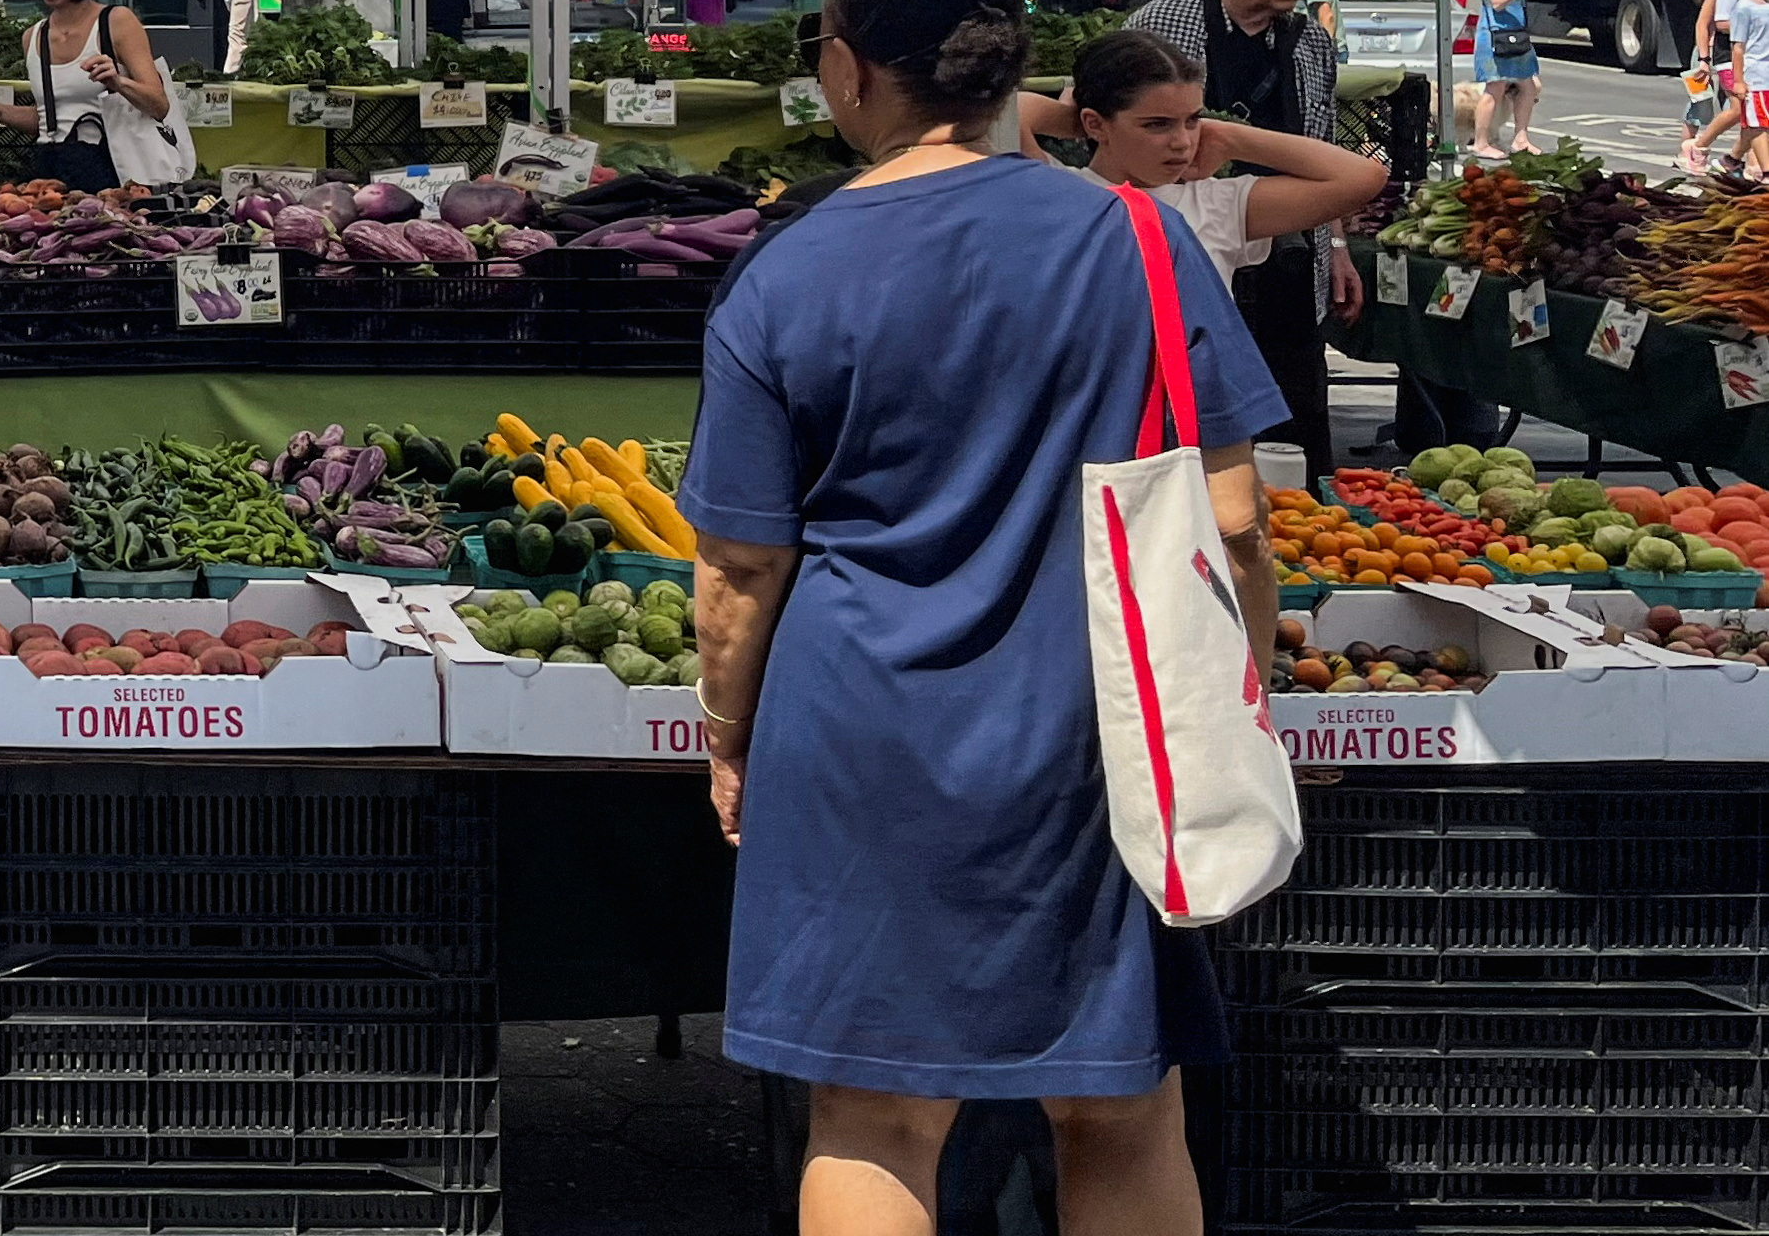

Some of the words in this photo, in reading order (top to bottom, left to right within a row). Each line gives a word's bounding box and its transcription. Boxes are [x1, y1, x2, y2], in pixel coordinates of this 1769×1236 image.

[114, 688, 185, 702] SELECTED
[55, 706, 244, 738] TOMATOES
[1317, 709, 1395, 724] SELECTED
[1280, 726, 1458, 761] OMATOES
